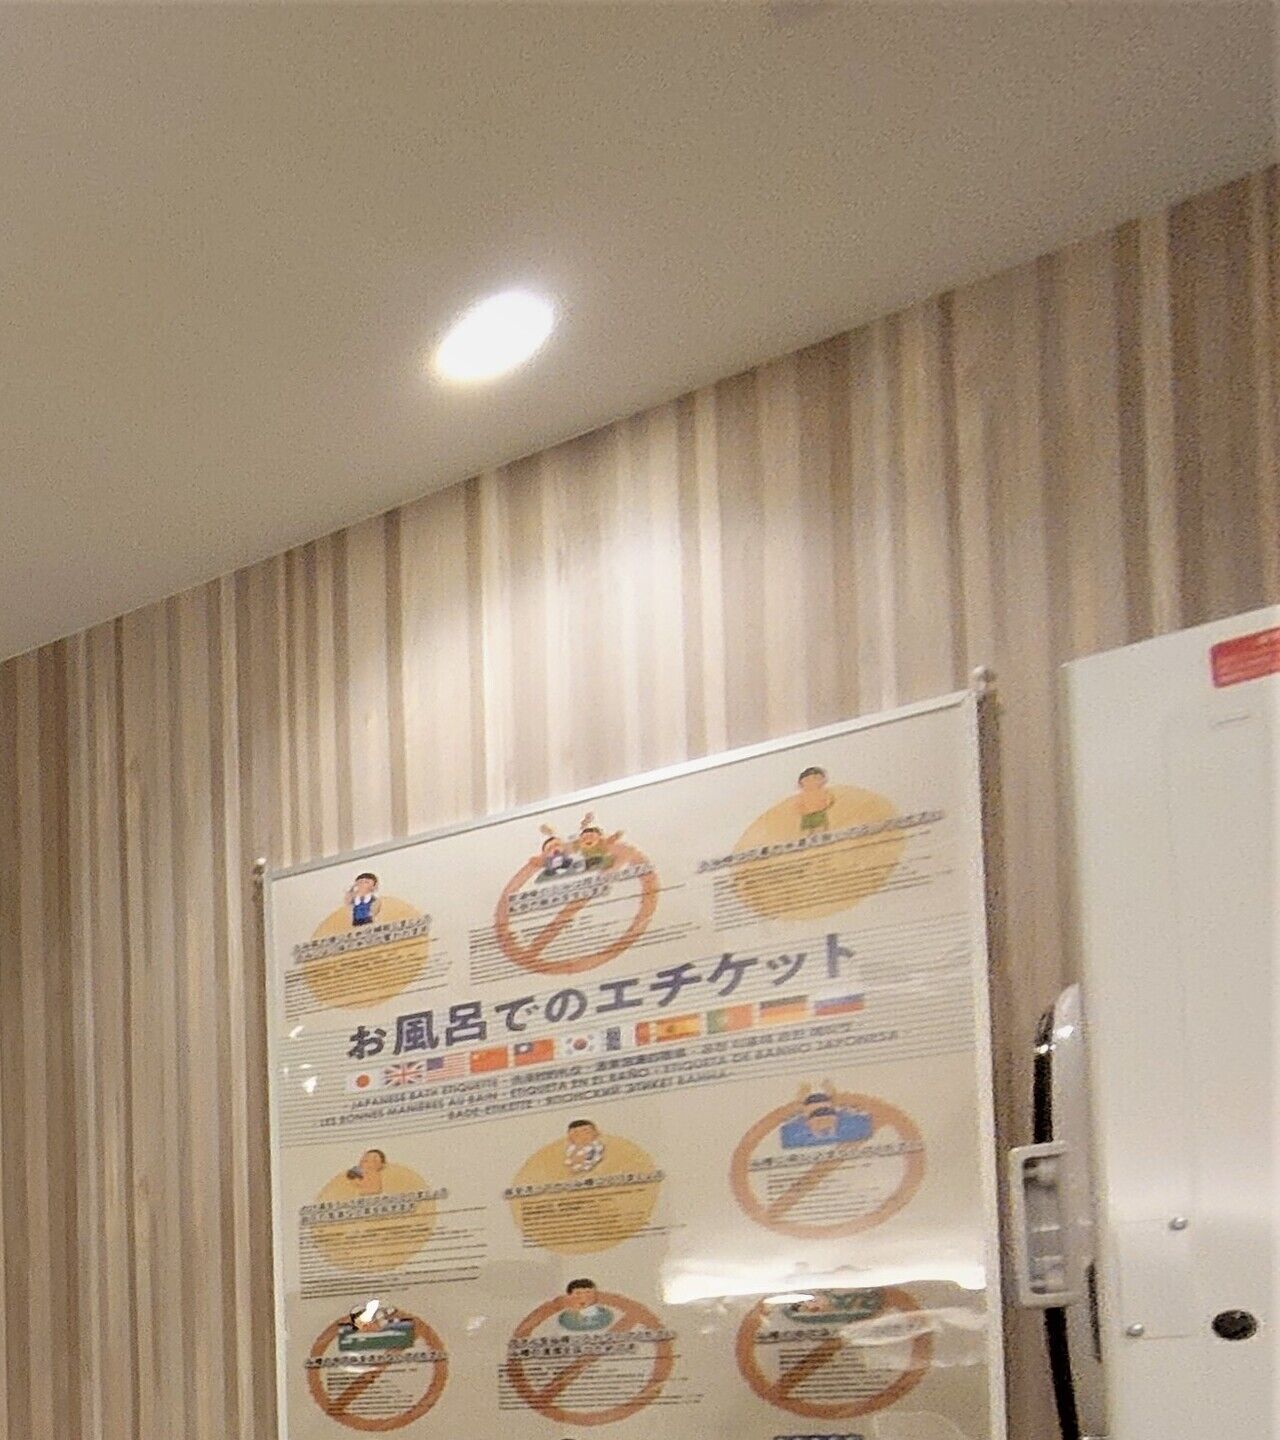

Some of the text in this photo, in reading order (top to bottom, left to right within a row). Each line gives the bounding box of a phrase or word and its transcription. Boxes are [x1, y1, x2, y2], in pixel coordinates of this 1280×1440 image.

[347, 933, 856, 1060] お風呂でのエチケット
